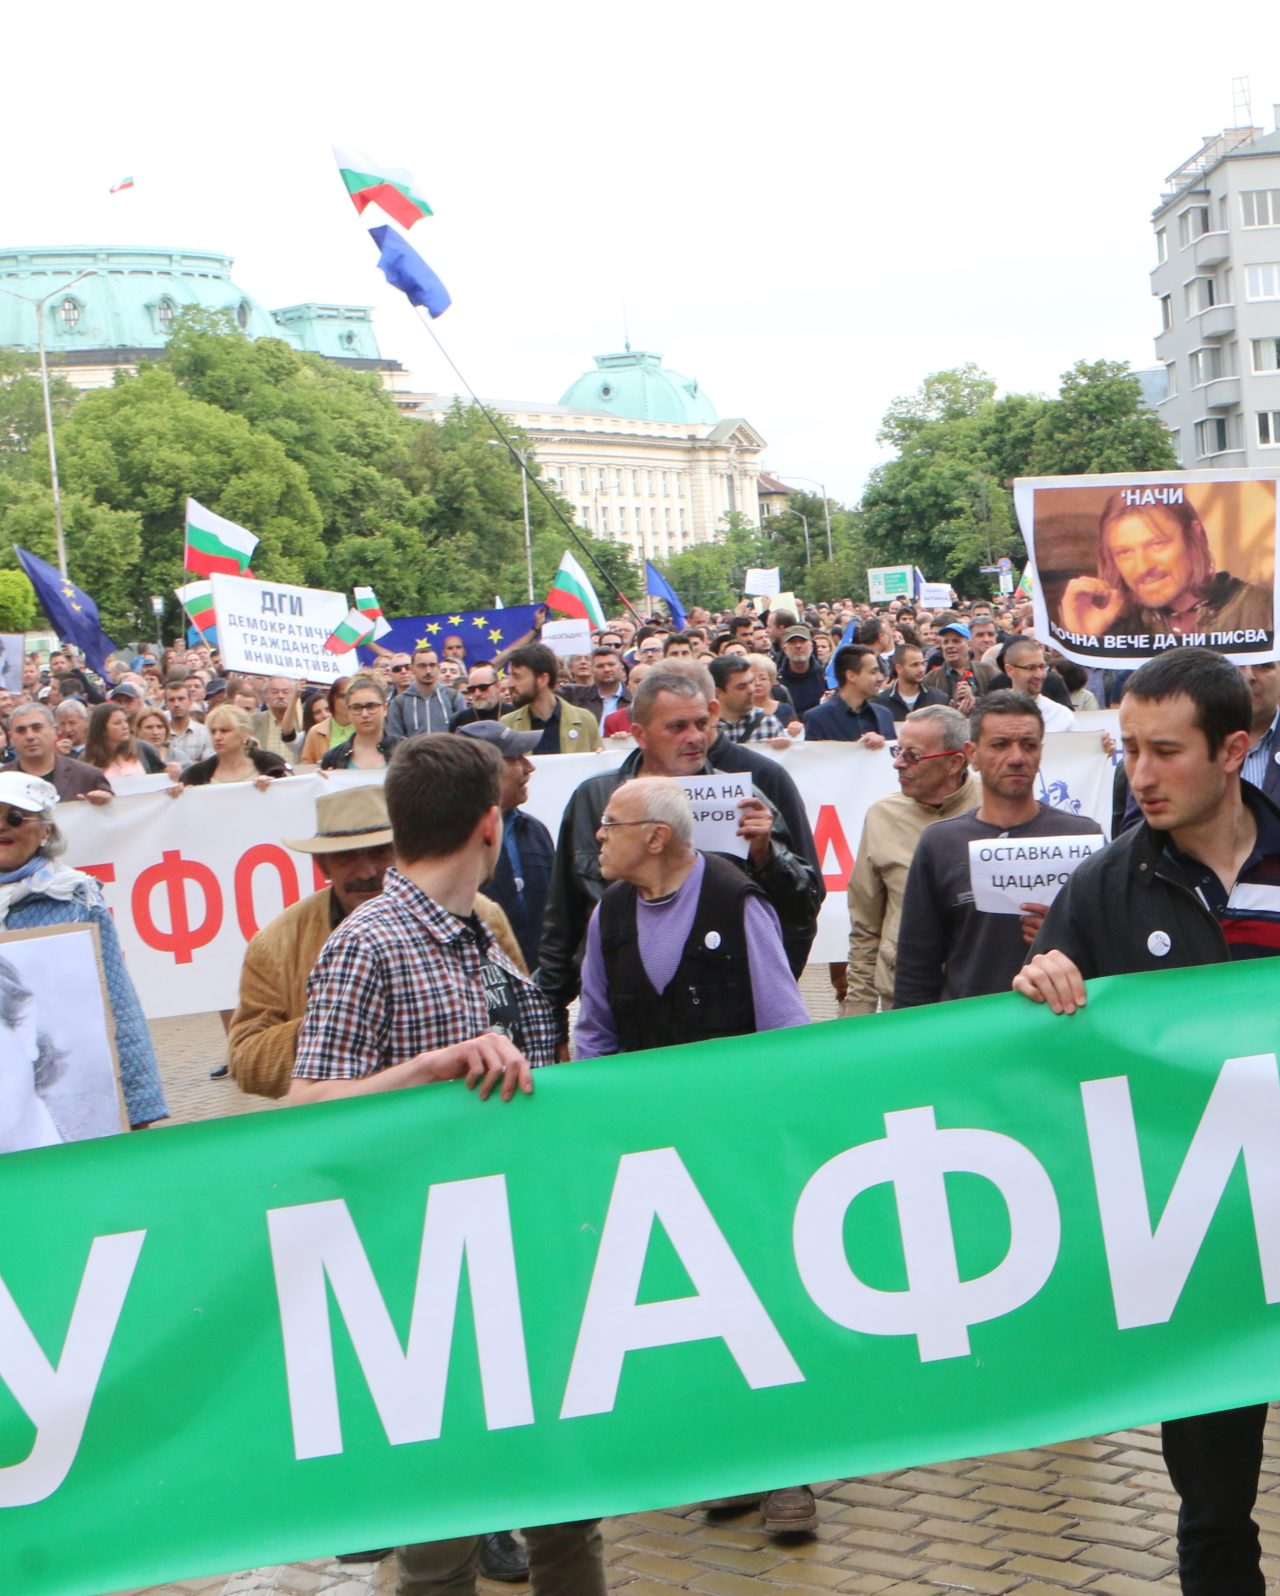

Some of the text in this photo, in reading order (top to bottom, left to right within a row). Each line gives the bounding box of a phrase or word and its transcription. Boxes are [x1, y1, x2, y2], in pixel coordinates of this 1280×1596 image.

[261, 590, 304, 617] ДГИ
[228, 613, 333, 639] ДЕМОКРАТИЧН
[1103, 634, 1150, 649] ВЕЧЕ
[1153, 632, 1177, 650] ДА
[1182, 631, 1206, 647] НИ
[1210, 628, 1268, 646] ПИСВА
[244, 649, 341, 673] ИНИЦИАТИВА
[722, 784, 745, 799] НА
[980, 845, 1092, 862] ОСТАВКА НА
[992, 873, 1071, 890] ЦАЦАРО
